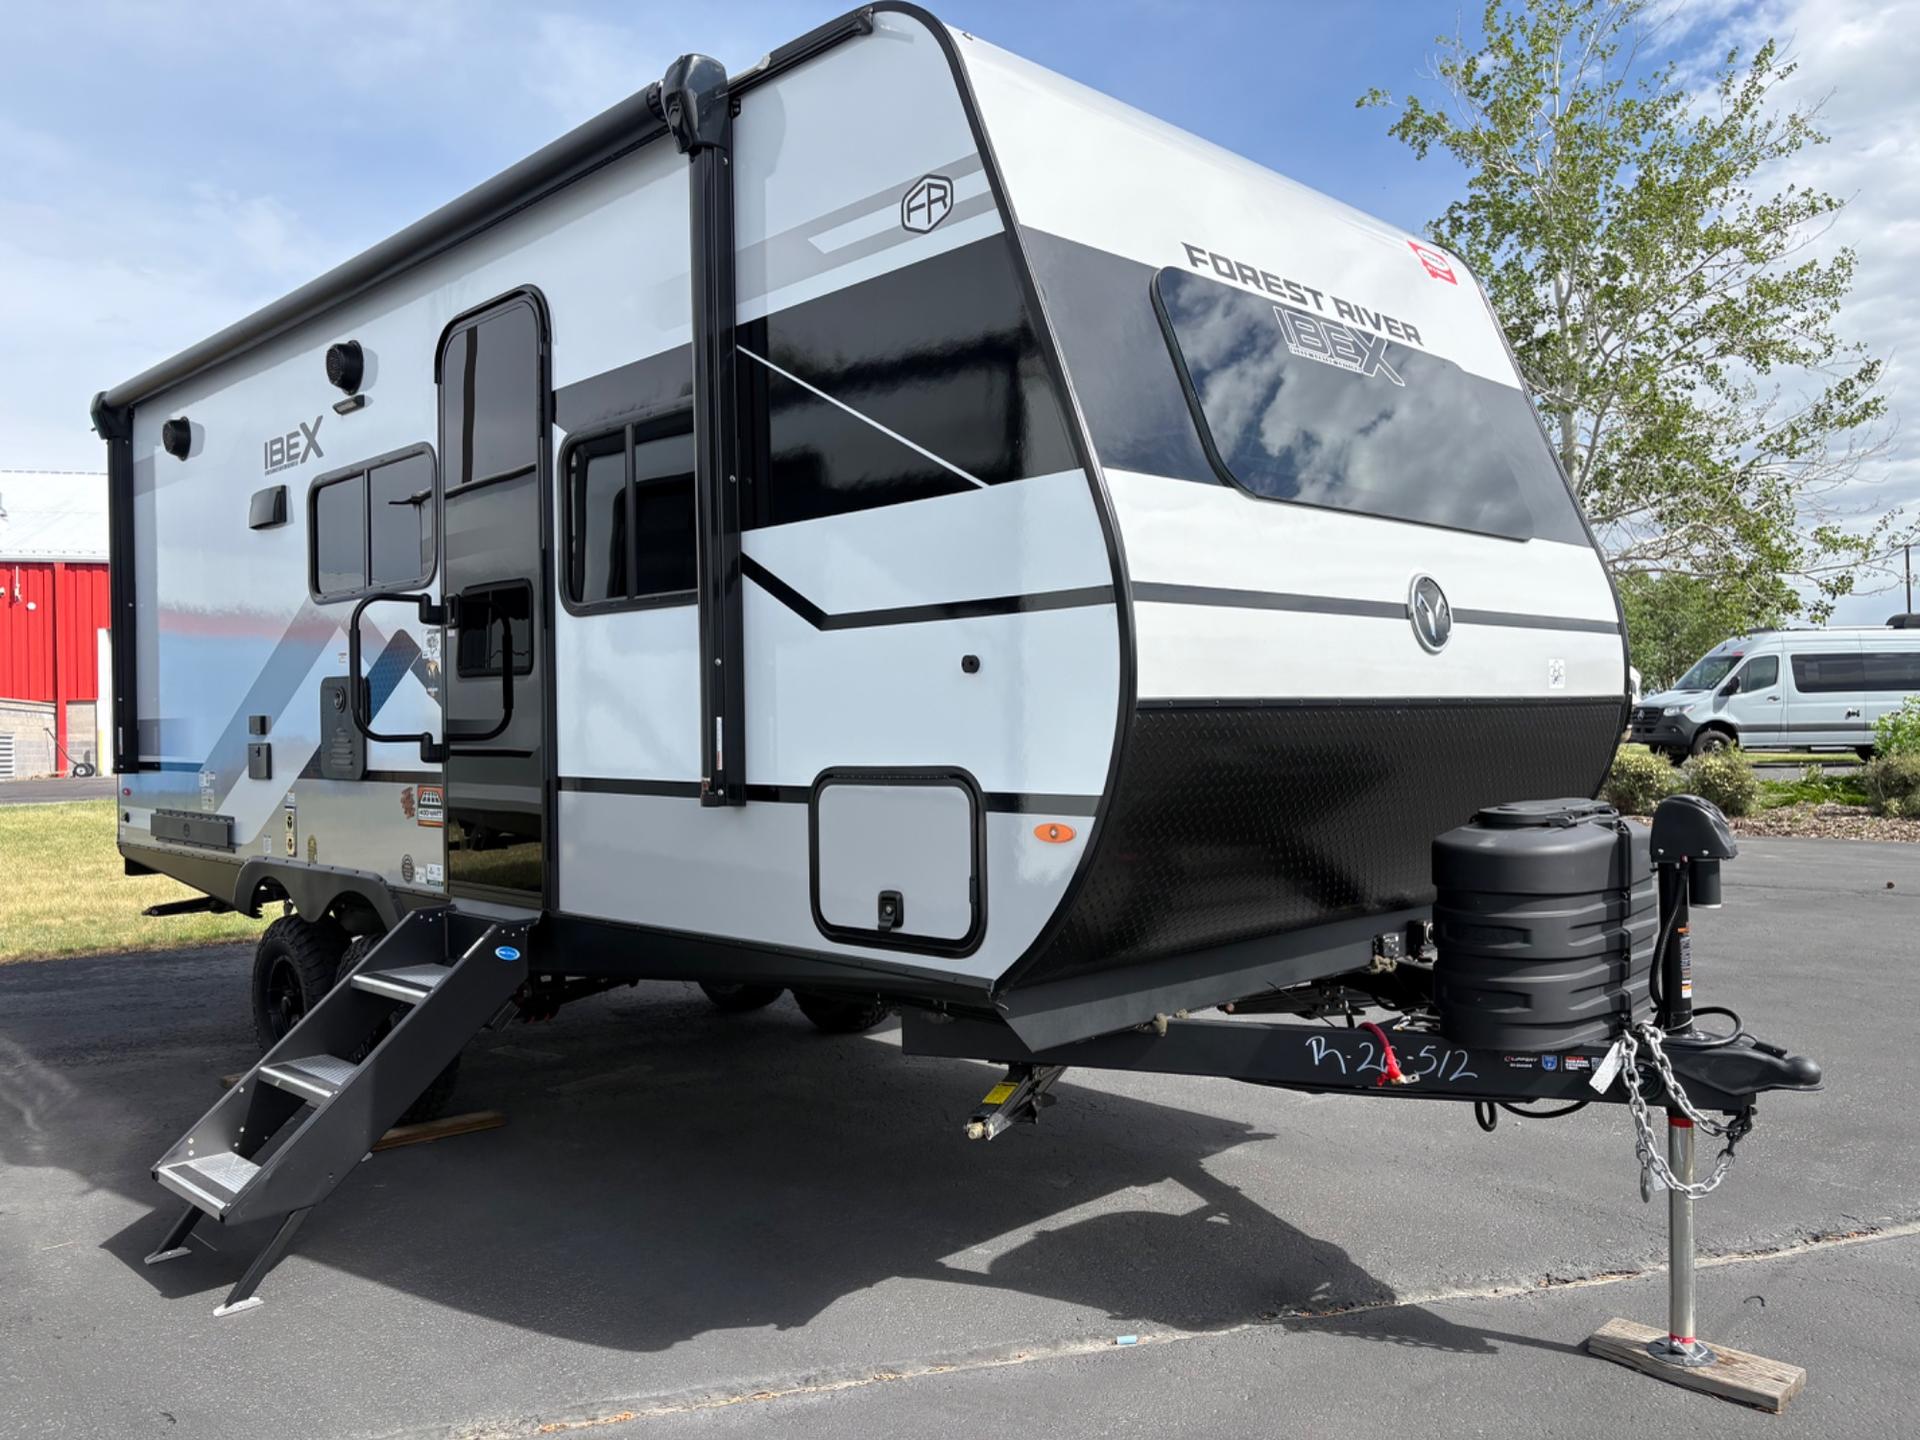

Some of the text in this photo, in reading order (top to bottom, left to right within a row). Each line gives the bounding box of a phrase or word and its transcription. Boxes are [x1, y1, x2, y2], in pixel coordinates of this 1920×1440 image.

[1181, 242, 1424, 346] FOREST RIVER
[1273, 306, 1405, 387] IBEX
[264, 415, 324, 470] IBEX
